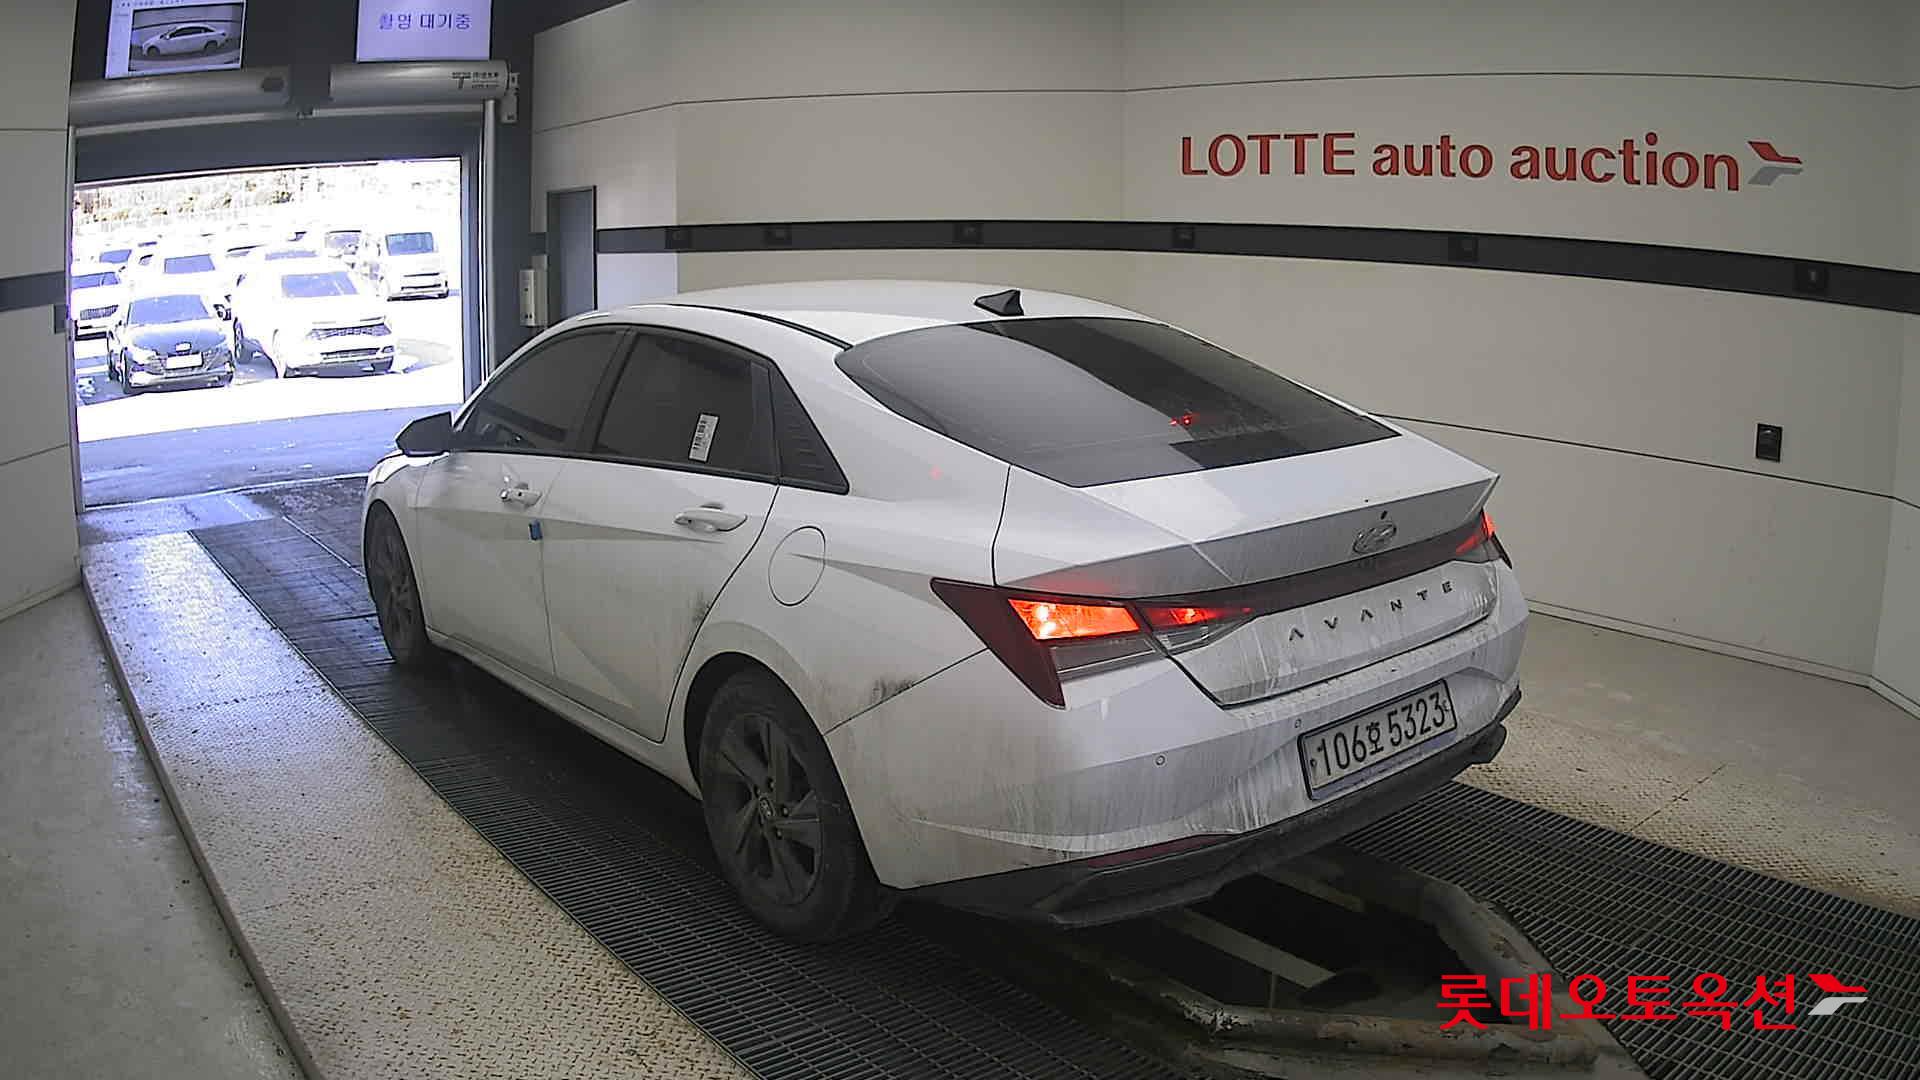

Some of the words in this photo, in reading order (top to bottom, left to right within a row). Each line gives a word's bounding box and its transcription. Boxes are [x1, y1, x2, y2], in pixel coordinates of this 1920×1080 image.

[420, 13, 472, 30] 대기중
[1182, 133, 1355, 176] LOTTE
[1373, 136, 1493, 178] auto
[1510, 132, 1739, 191] auction
[1289, 580, 1453, 641] AVANTE
